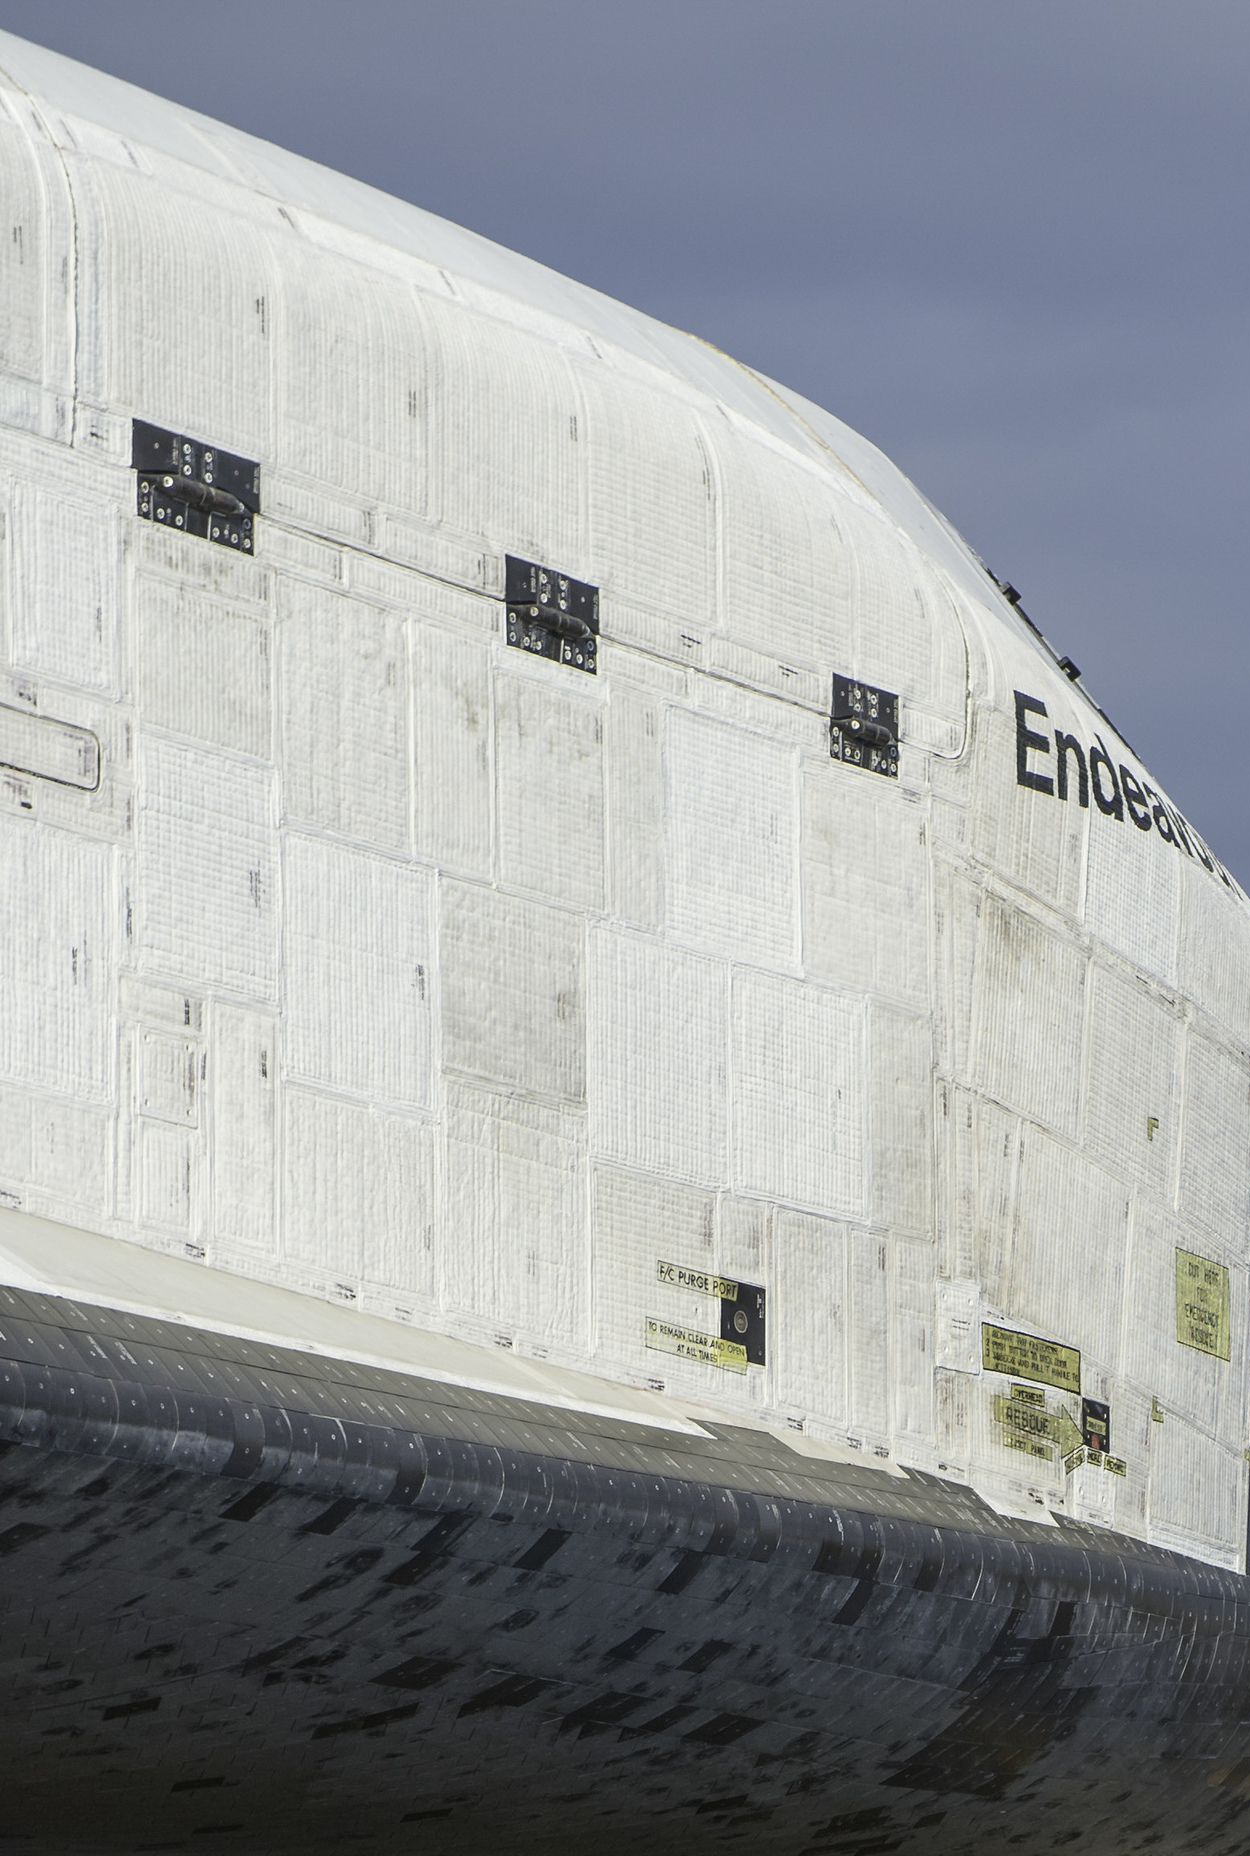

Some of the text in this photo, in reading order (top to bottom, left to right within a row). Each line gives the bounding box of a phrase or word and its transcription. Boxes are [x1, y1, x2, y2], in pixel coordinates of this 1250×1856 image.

[659, 1265, 737, 1298] F/C PURGE PORT
[648, 1321, 745, 1357] TO REMAIN CLEAR AND OPEN
[676, 1344, 718, 1363] AT ALL TIMES
[1006, 1406, 1050, 1435] RESCUE
